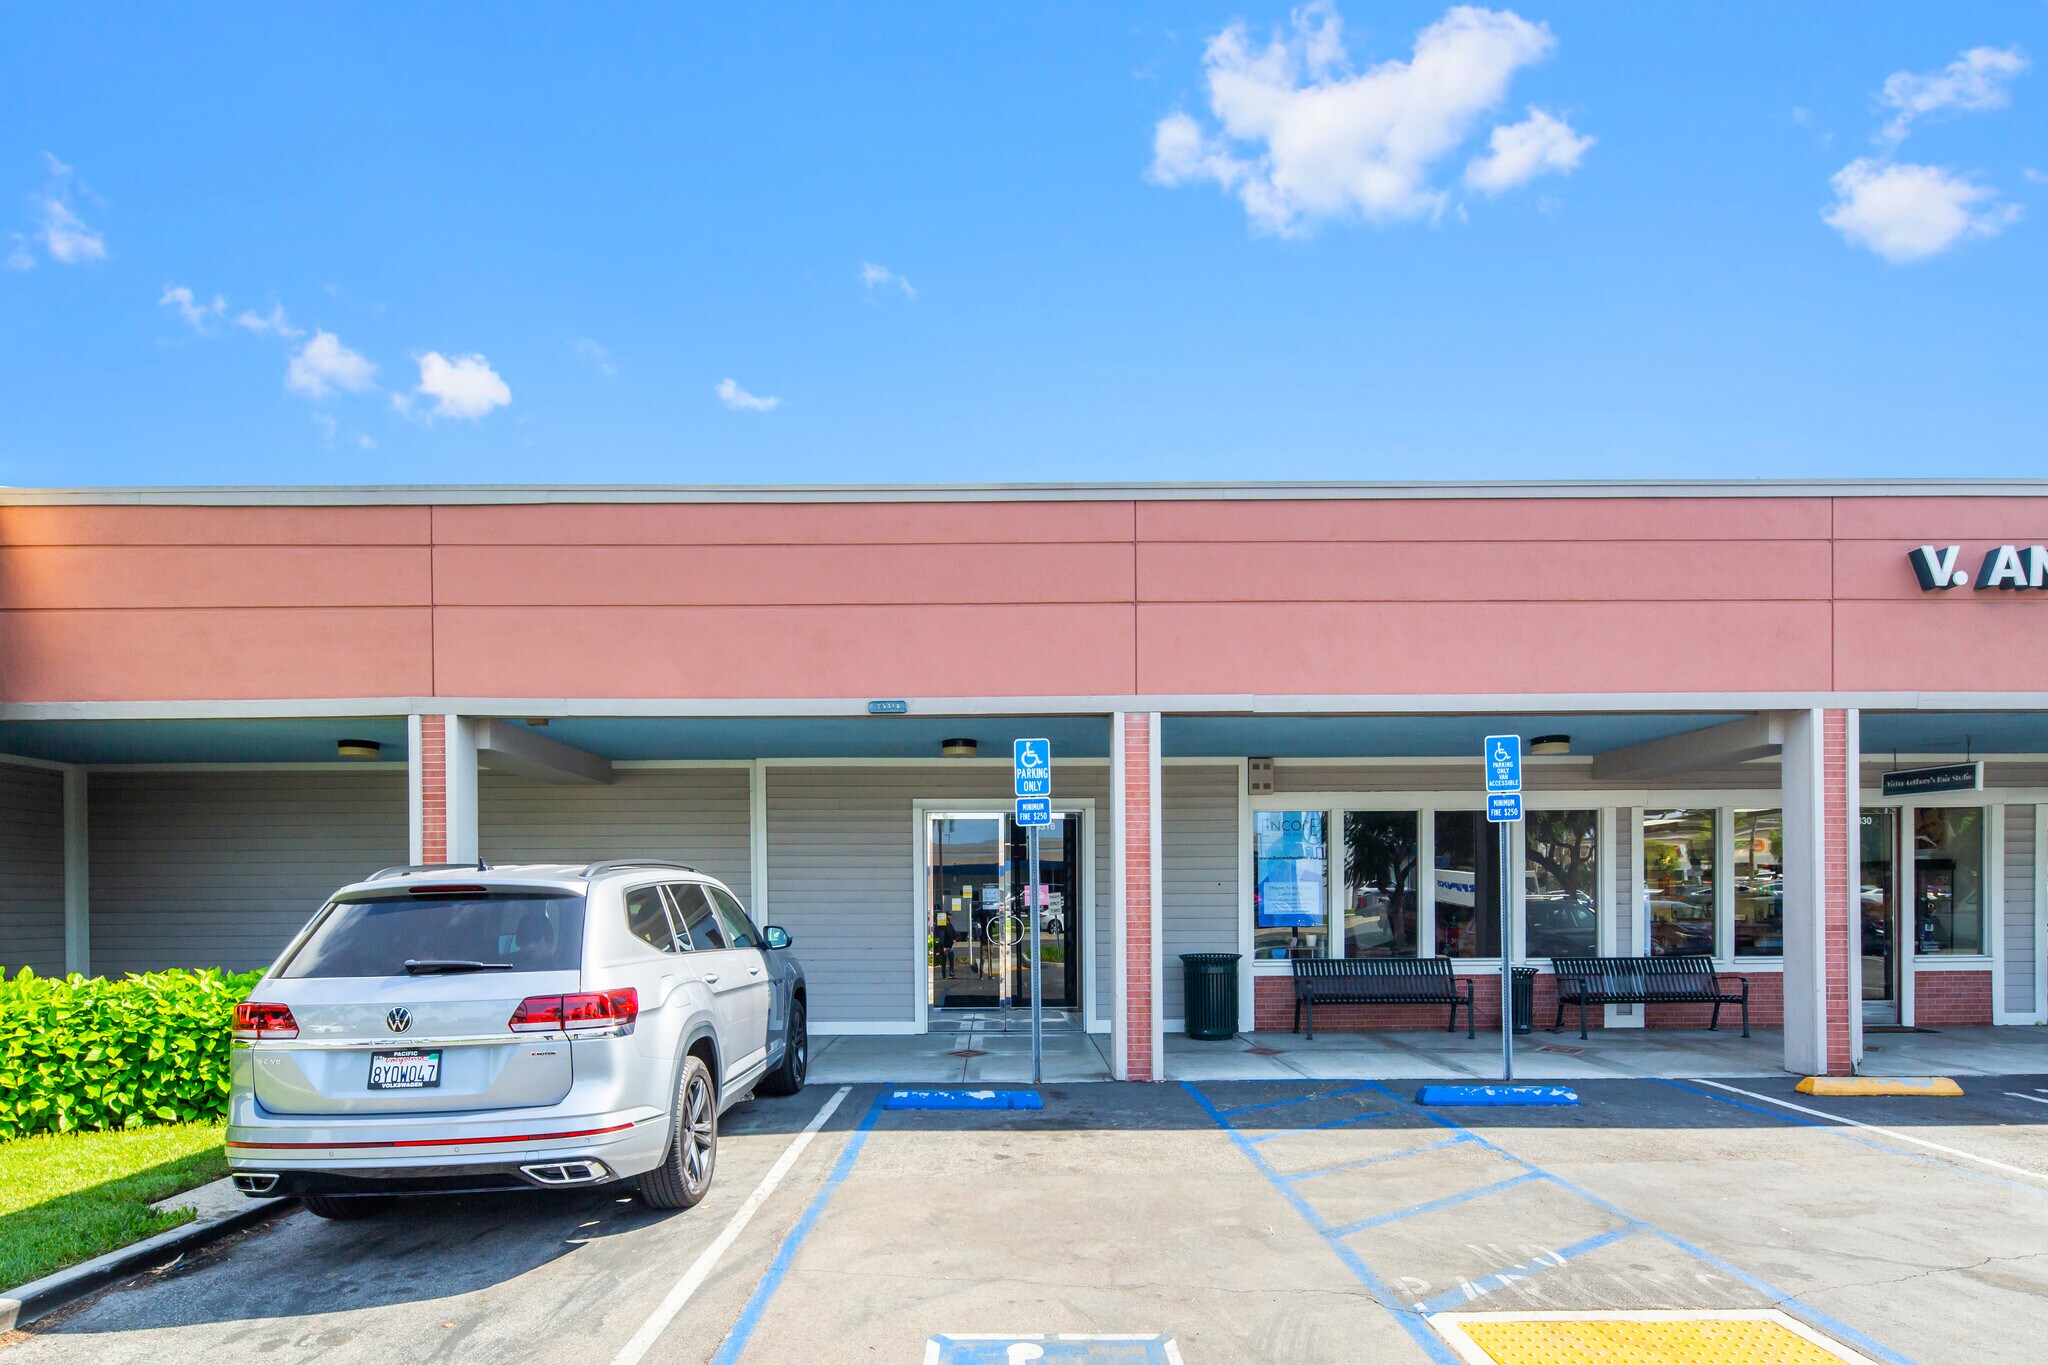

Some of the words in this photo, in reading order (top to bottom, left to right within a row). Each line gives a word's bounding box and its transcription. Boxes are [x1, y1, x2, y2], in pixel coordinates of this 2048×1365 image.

[1914, 545, 1969, 588] V.
[1016, 767, 1049, 779] PARKING
[1496, 767, 1510, 775] ONLY
[1023, 780, 1043, 792] ONLY
[1488, 779, 1519, 787] ACCESSIBLE
[1022, 802, 1045, 811] MINIMUM
[1493, 798, 1515, 807] MINIMUM
[1490, 808, 1502, 816] FINE
[1503, 807, 1519, 816] $250
[1019, 812, 1031, 821] FINE
[1033, 812, 1048, 821] $250
[1859, 816, 1872, 825] 30
[381, 1081, 423, 1089] VOLKSWAGEN
